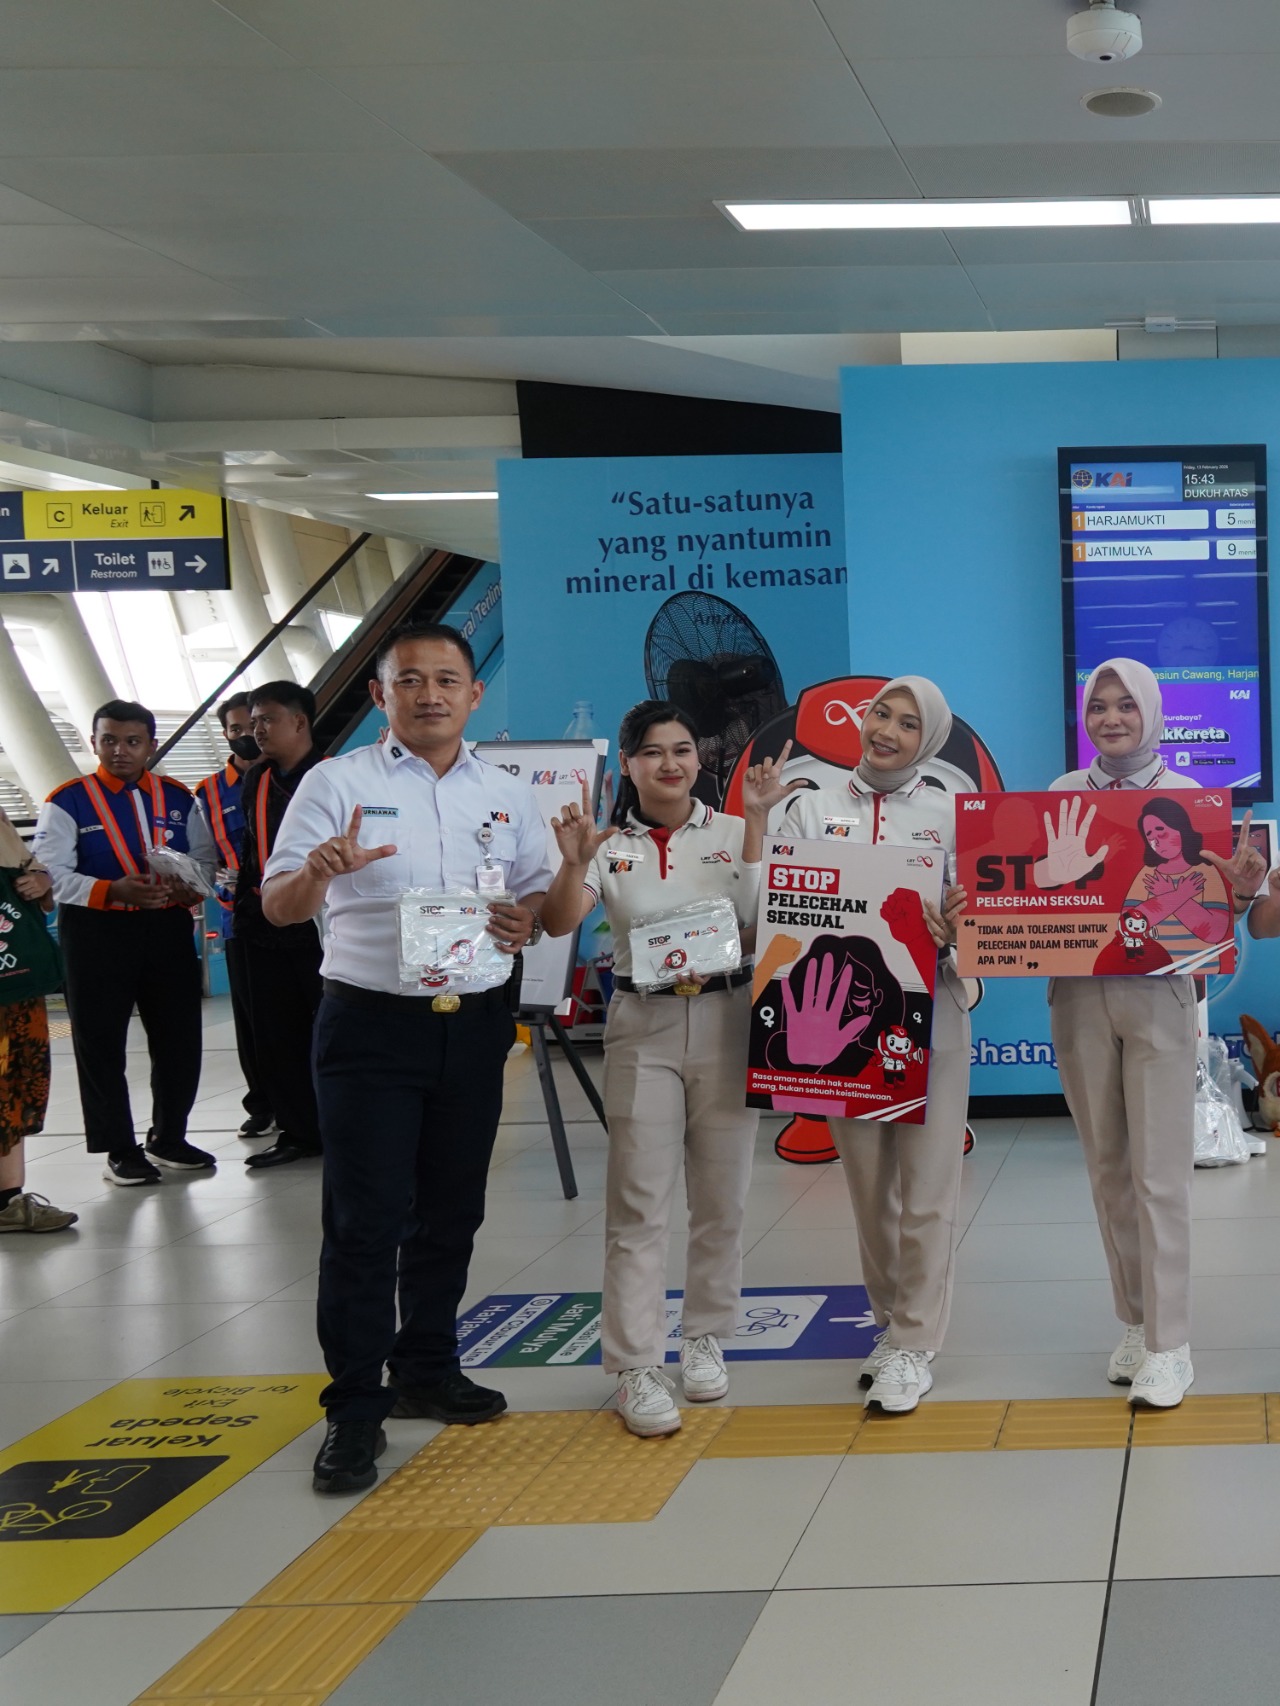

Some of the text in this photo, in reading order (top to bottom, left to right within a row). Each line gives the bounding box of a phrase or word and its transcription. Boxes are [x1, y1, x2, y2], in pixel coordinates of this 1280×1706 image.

[1185, 474, 1215, 485] 15:43
[1185, 488, 1249, 498] DUKUH ATAS
[82, 503, 128, 516] Keluar
[54, 511, 65, 522] C
[1075, 515, 1083, 527] 1
[1087, 515, 1165, 527] HARJAMUKTI
[1227, 512, 1236, 526] 5
[110, 519, 129, 528] Exit
[598, 522, 831, 562] yang nyantumin
[1076, 546, 1083, 558] 1
[1088, 546, 1153, 557] JATIMULYA
[1228, 543, 1237, 556] 9
[94, 553, 136, 565] Toilet
[90, 569, 137, 579] Restroom
[566, 563, 848, 594] mineral di kemasan
[1154, 671, 1180, 681] asiun
[1181, 670, 1225, 682] Cawang,
[773, 868, 835, 891] STOP
[768, 892, 867, 914] PELECEHAN
[976, 895, 1105, 908] PELECEHAN SEKSUAL
[767, 910, 844, 929] SEKSUAL
[978, 923, 1107, 935] TIDAK ADA TOLERANSI UNTUK
[648, 935, 671, 946] STOP
[978, 939, 1098, 950] PELECEHAN DALAM BENTUK
[978, 955, 995, 965] APA
[998, 955, 1016, 965] PUN
[753, 1072, 871, 1090] Rasa aman adalah hak semua
[779, 1084, 804, 1092] bukan
[805, 1086, 834, 1095] sebuah
[836, 1089, 893, 1101] keistimewaan.
[162, 1385, 255, 1396] Bicycle
[110, 1415, 259, 1431] Sepeda
[84, 1434, 222, 1448] Keluar
